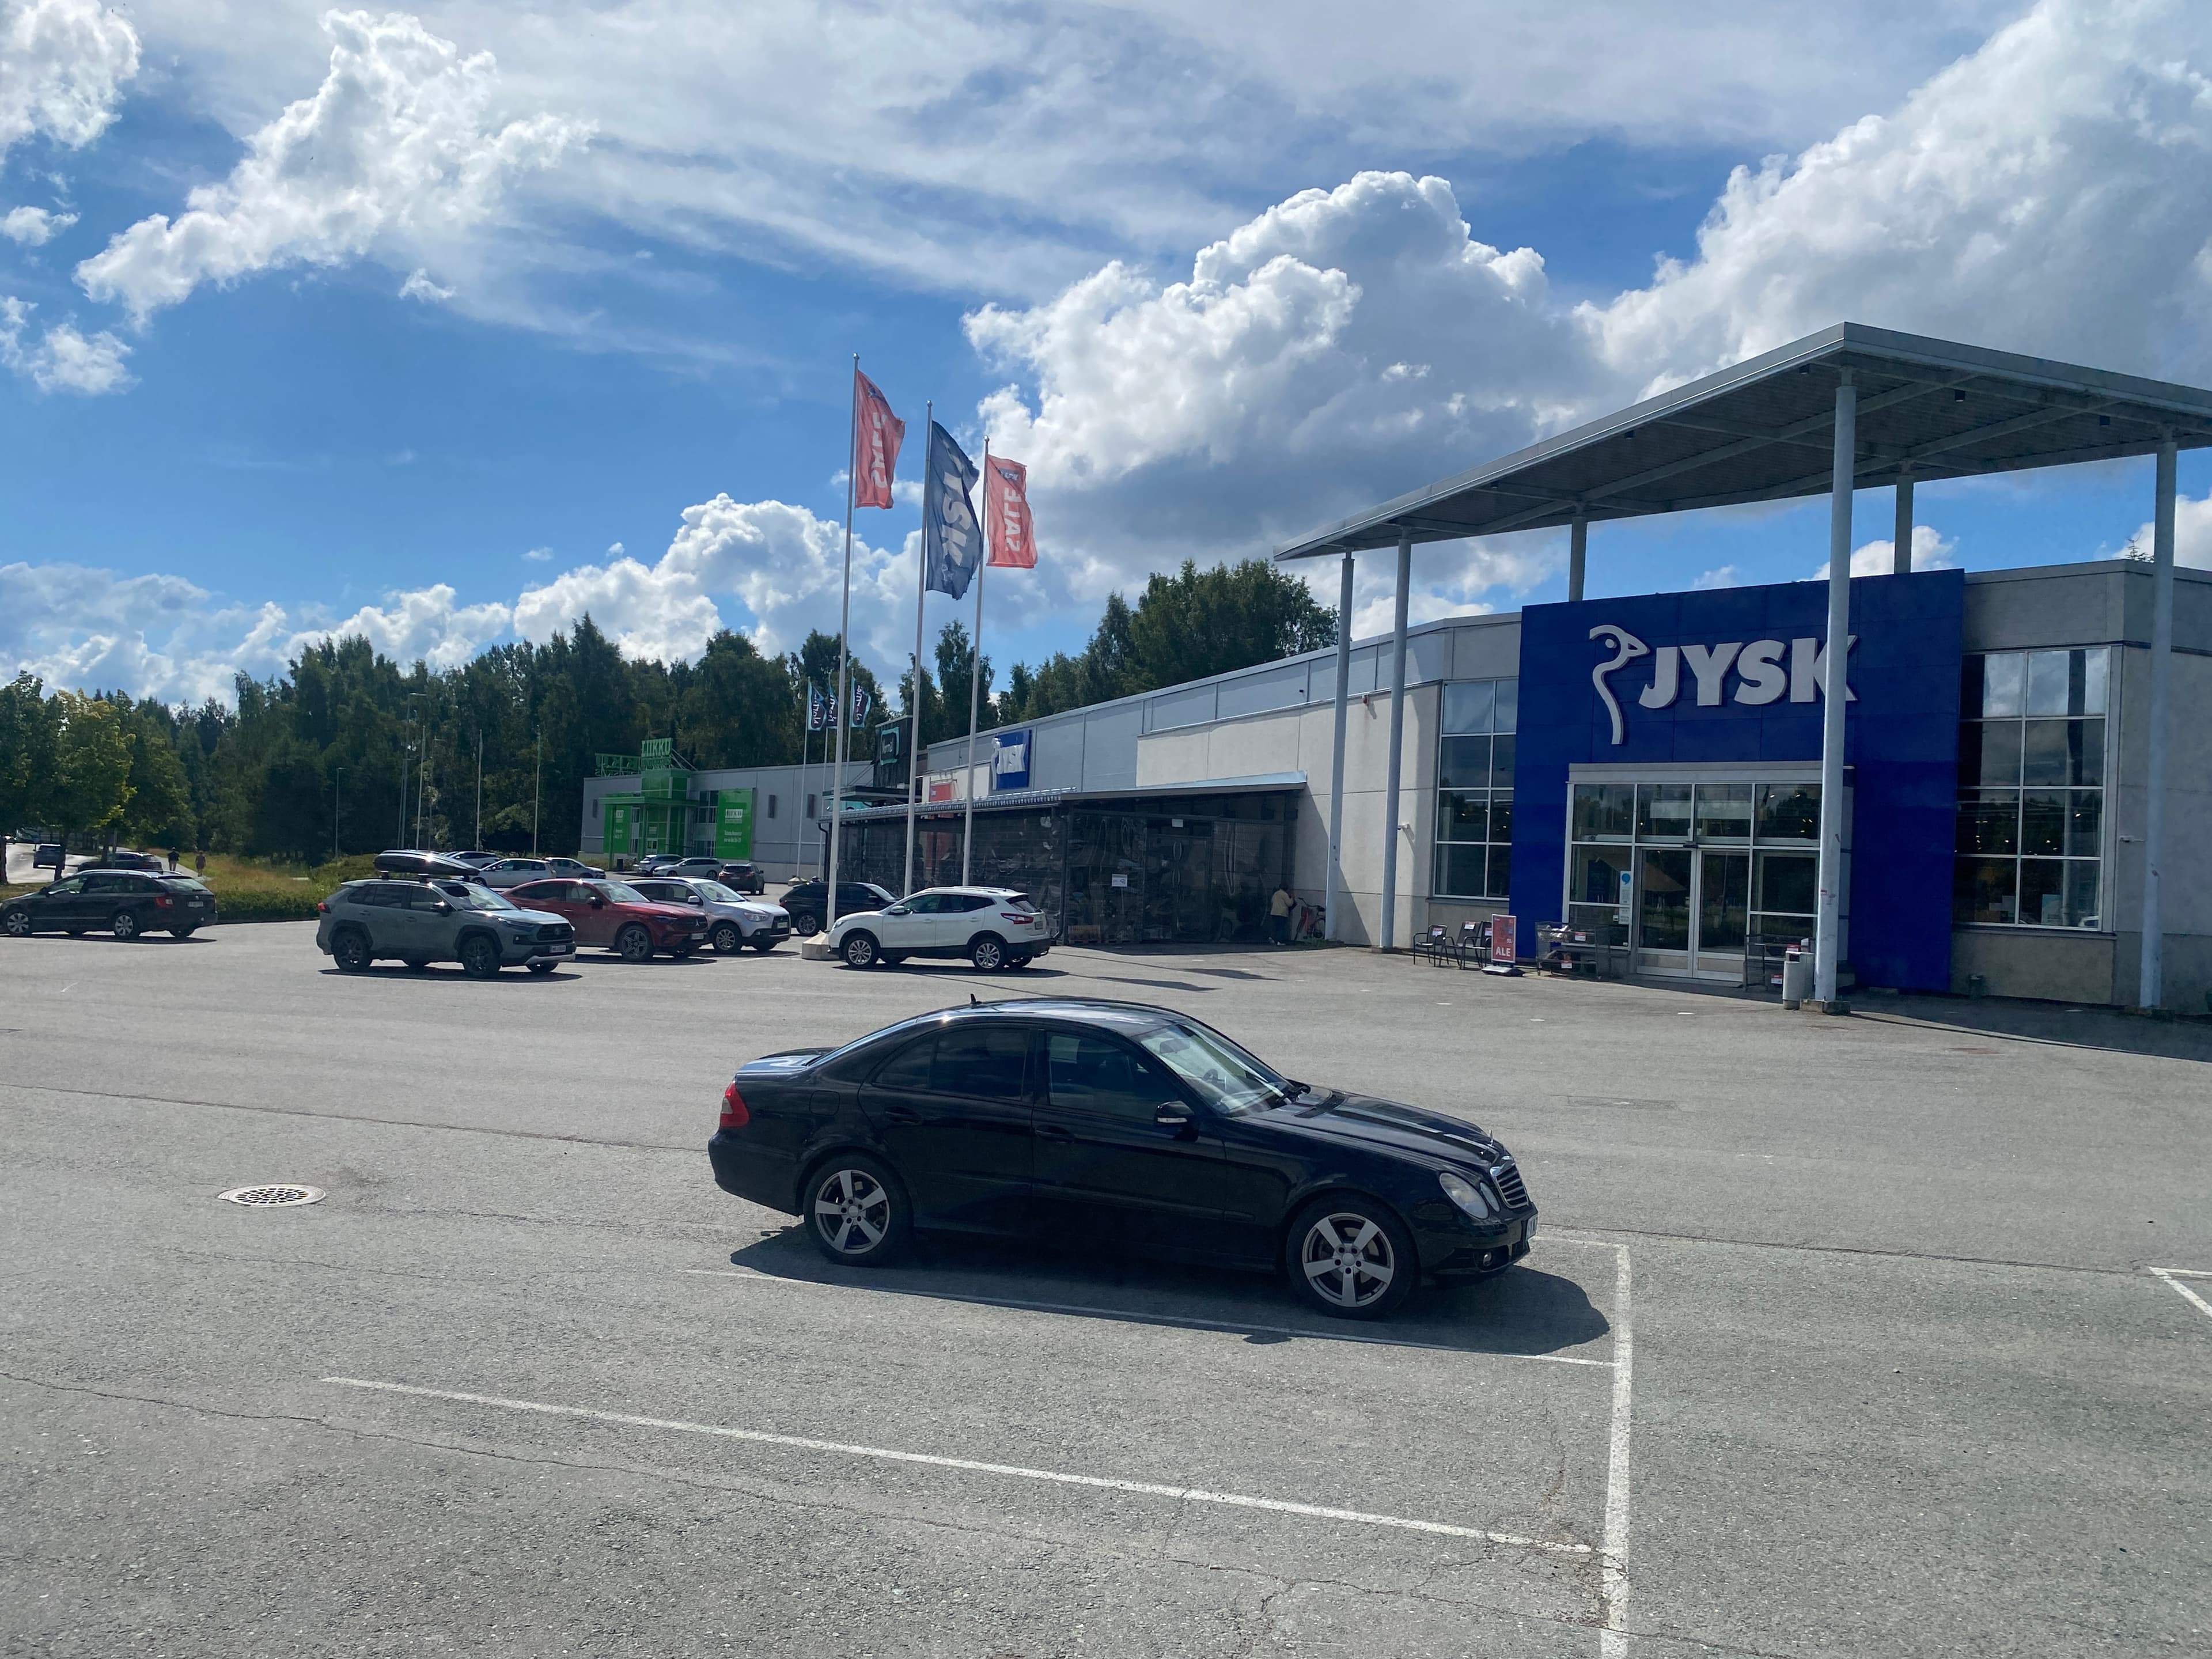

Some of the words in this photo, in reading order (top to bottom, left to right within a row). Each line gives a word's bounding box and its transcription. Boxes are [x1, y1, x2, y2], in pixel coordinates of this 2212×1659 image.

[1638, 634, 1858, 709] JYSK
[641, 737, 672, 757] LIIKKU
[1495, 946, 1512, 957] ALE
